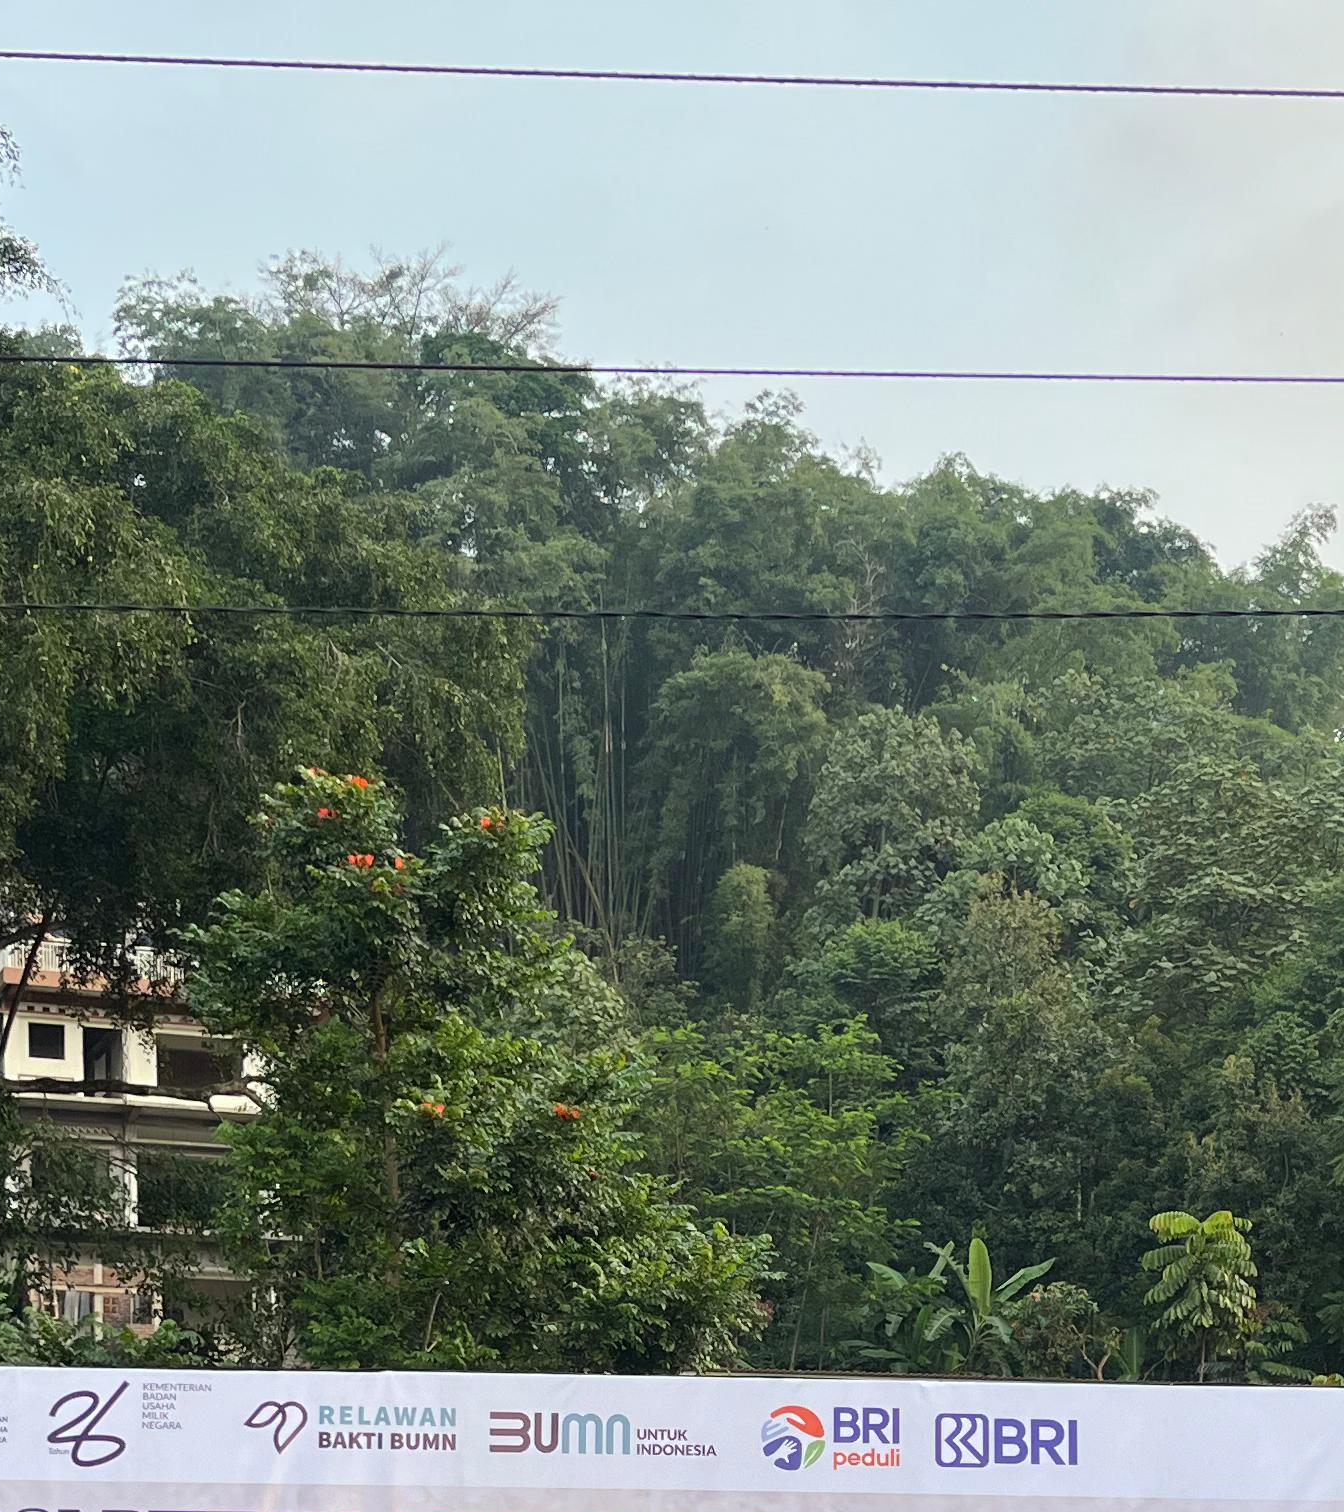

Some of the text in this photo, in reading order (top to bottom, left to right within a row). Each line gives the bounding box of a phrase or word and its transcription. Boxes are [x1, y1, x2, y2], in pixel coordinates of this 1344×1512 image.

[142, 1383, 212, 1392] KEMENTERIAN
[142, 1392, 177, 1401] BADAN
[142, 1402, 176, 1410] USAHA
[142, 1411, 169, 1420] MILIK
[318, 1405, 456, 1427] RELAWAN
[141, 1421, 182, 1430] NEGARA
[833, 1407, 900, 1444] BRI
[489, 1411, 631, 1455] BUMN
[636, 1429, 688, 1441] UNTUK
[318, 1431, 456, 1451] BAKTI BUMN
[994, 1418, 1079, 1466] BRI
[636, 1443, 717, 1457] INDONESIA
[833, 1448, 901, 1470] peduli
